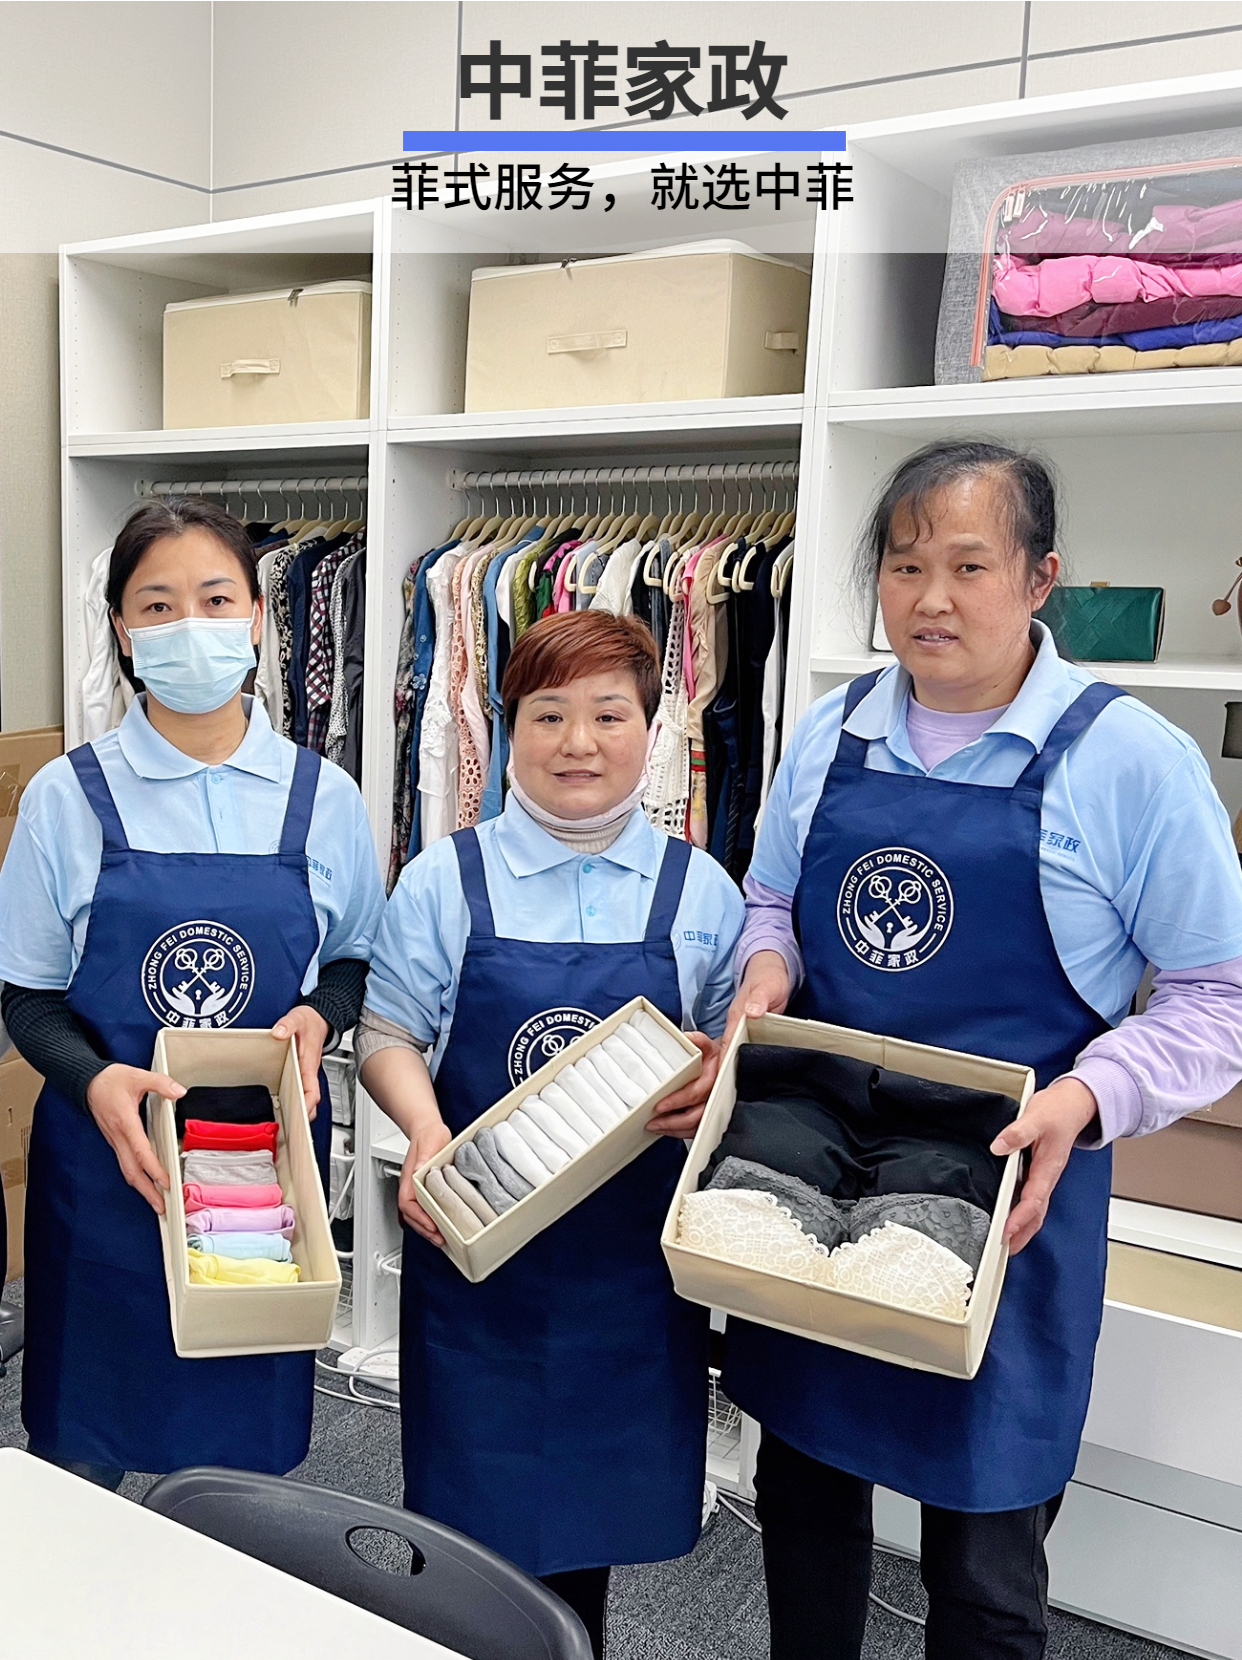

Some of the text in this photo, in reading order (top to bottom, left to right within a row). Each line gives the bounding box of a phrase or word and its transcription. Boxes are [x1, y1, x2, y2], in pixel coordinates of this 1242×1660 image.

[843, 854, 947, 931] ZHONG FEI DOMESTIC SERVICE
[148, 927, 250, 990] ZHONG FEI DOMESTIC SERVICE
[855, 940, 919, 967] 中菲家政
[514, 1013, 595, 1075] ZHONG FEI DOMESTI
